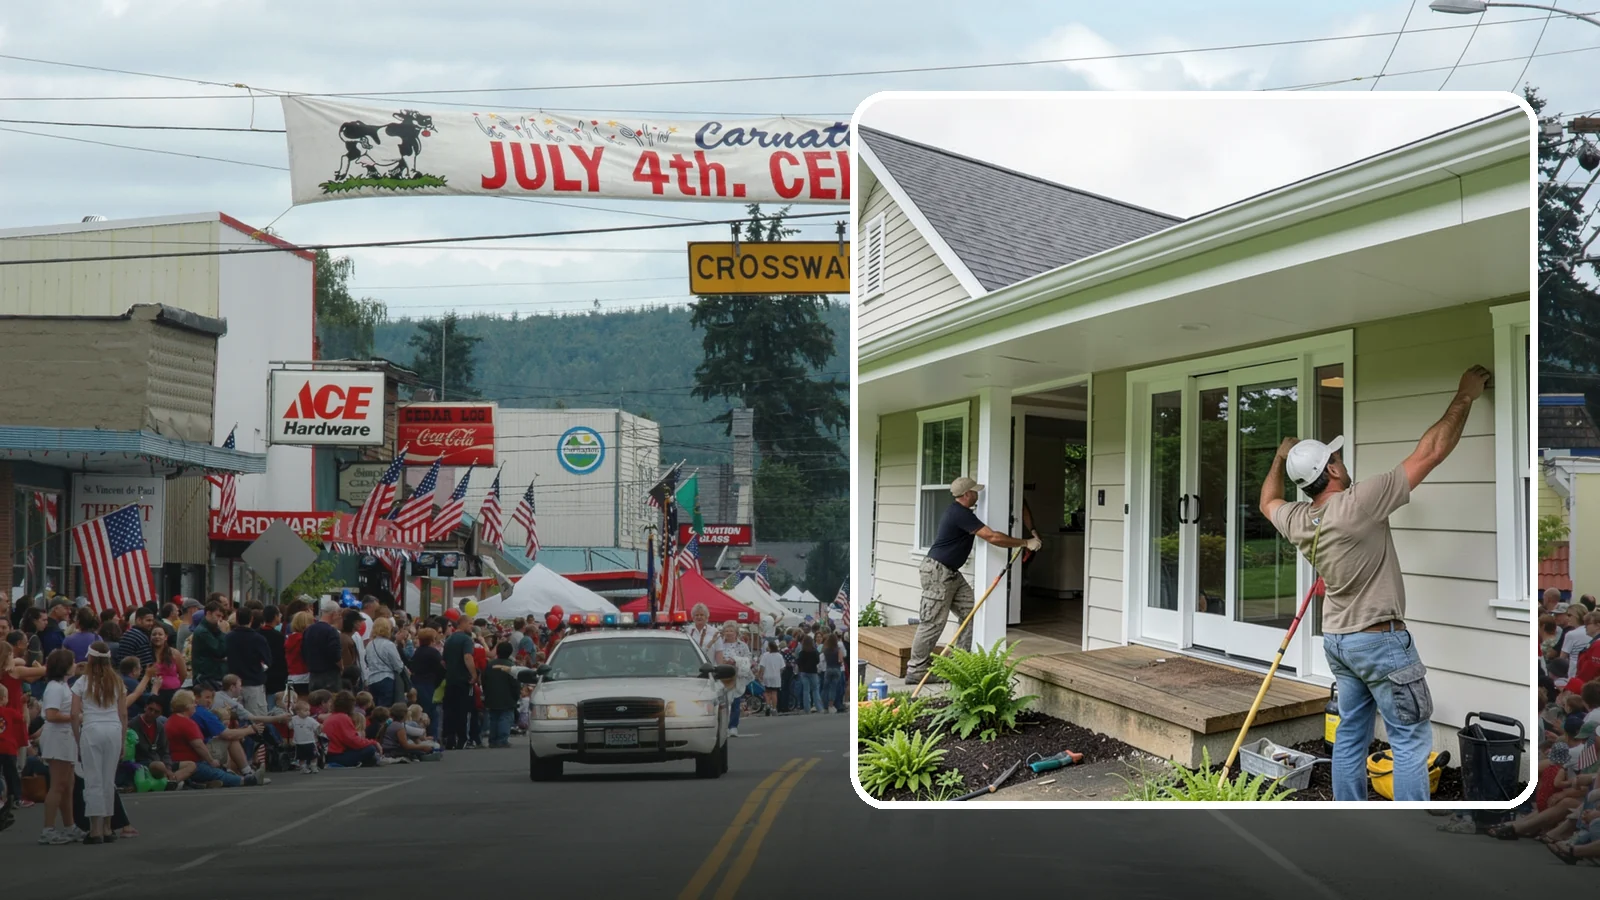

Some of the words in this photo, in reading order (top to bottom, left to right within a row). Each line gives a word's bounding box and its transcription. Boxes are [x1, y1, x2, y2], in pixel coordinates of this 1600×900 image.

[481, 141, 605, 192] JULY
[632, 150, 746, 197] 4th.
[697, 254, 850, 280] CROSSWA
[282, 380, 373, 420] ACE
[405, 409, 452, 422] CEDAR
[461, 409, 485, 422] LOG
[283, 421, 371, 436] Hardware
[416, 428, 477, 447] Coca-Cola
[83, 485, 93, 494] St.
[96, 485, 124, 494] Vincent
[126, 486, 135, 494] de
[138, 486, 155, 495] Paul
[213, 516, 331, 536] HARDARE
[688, 526, 741, 535] CRNATION
[699, 535, 730, 543] GLASS
